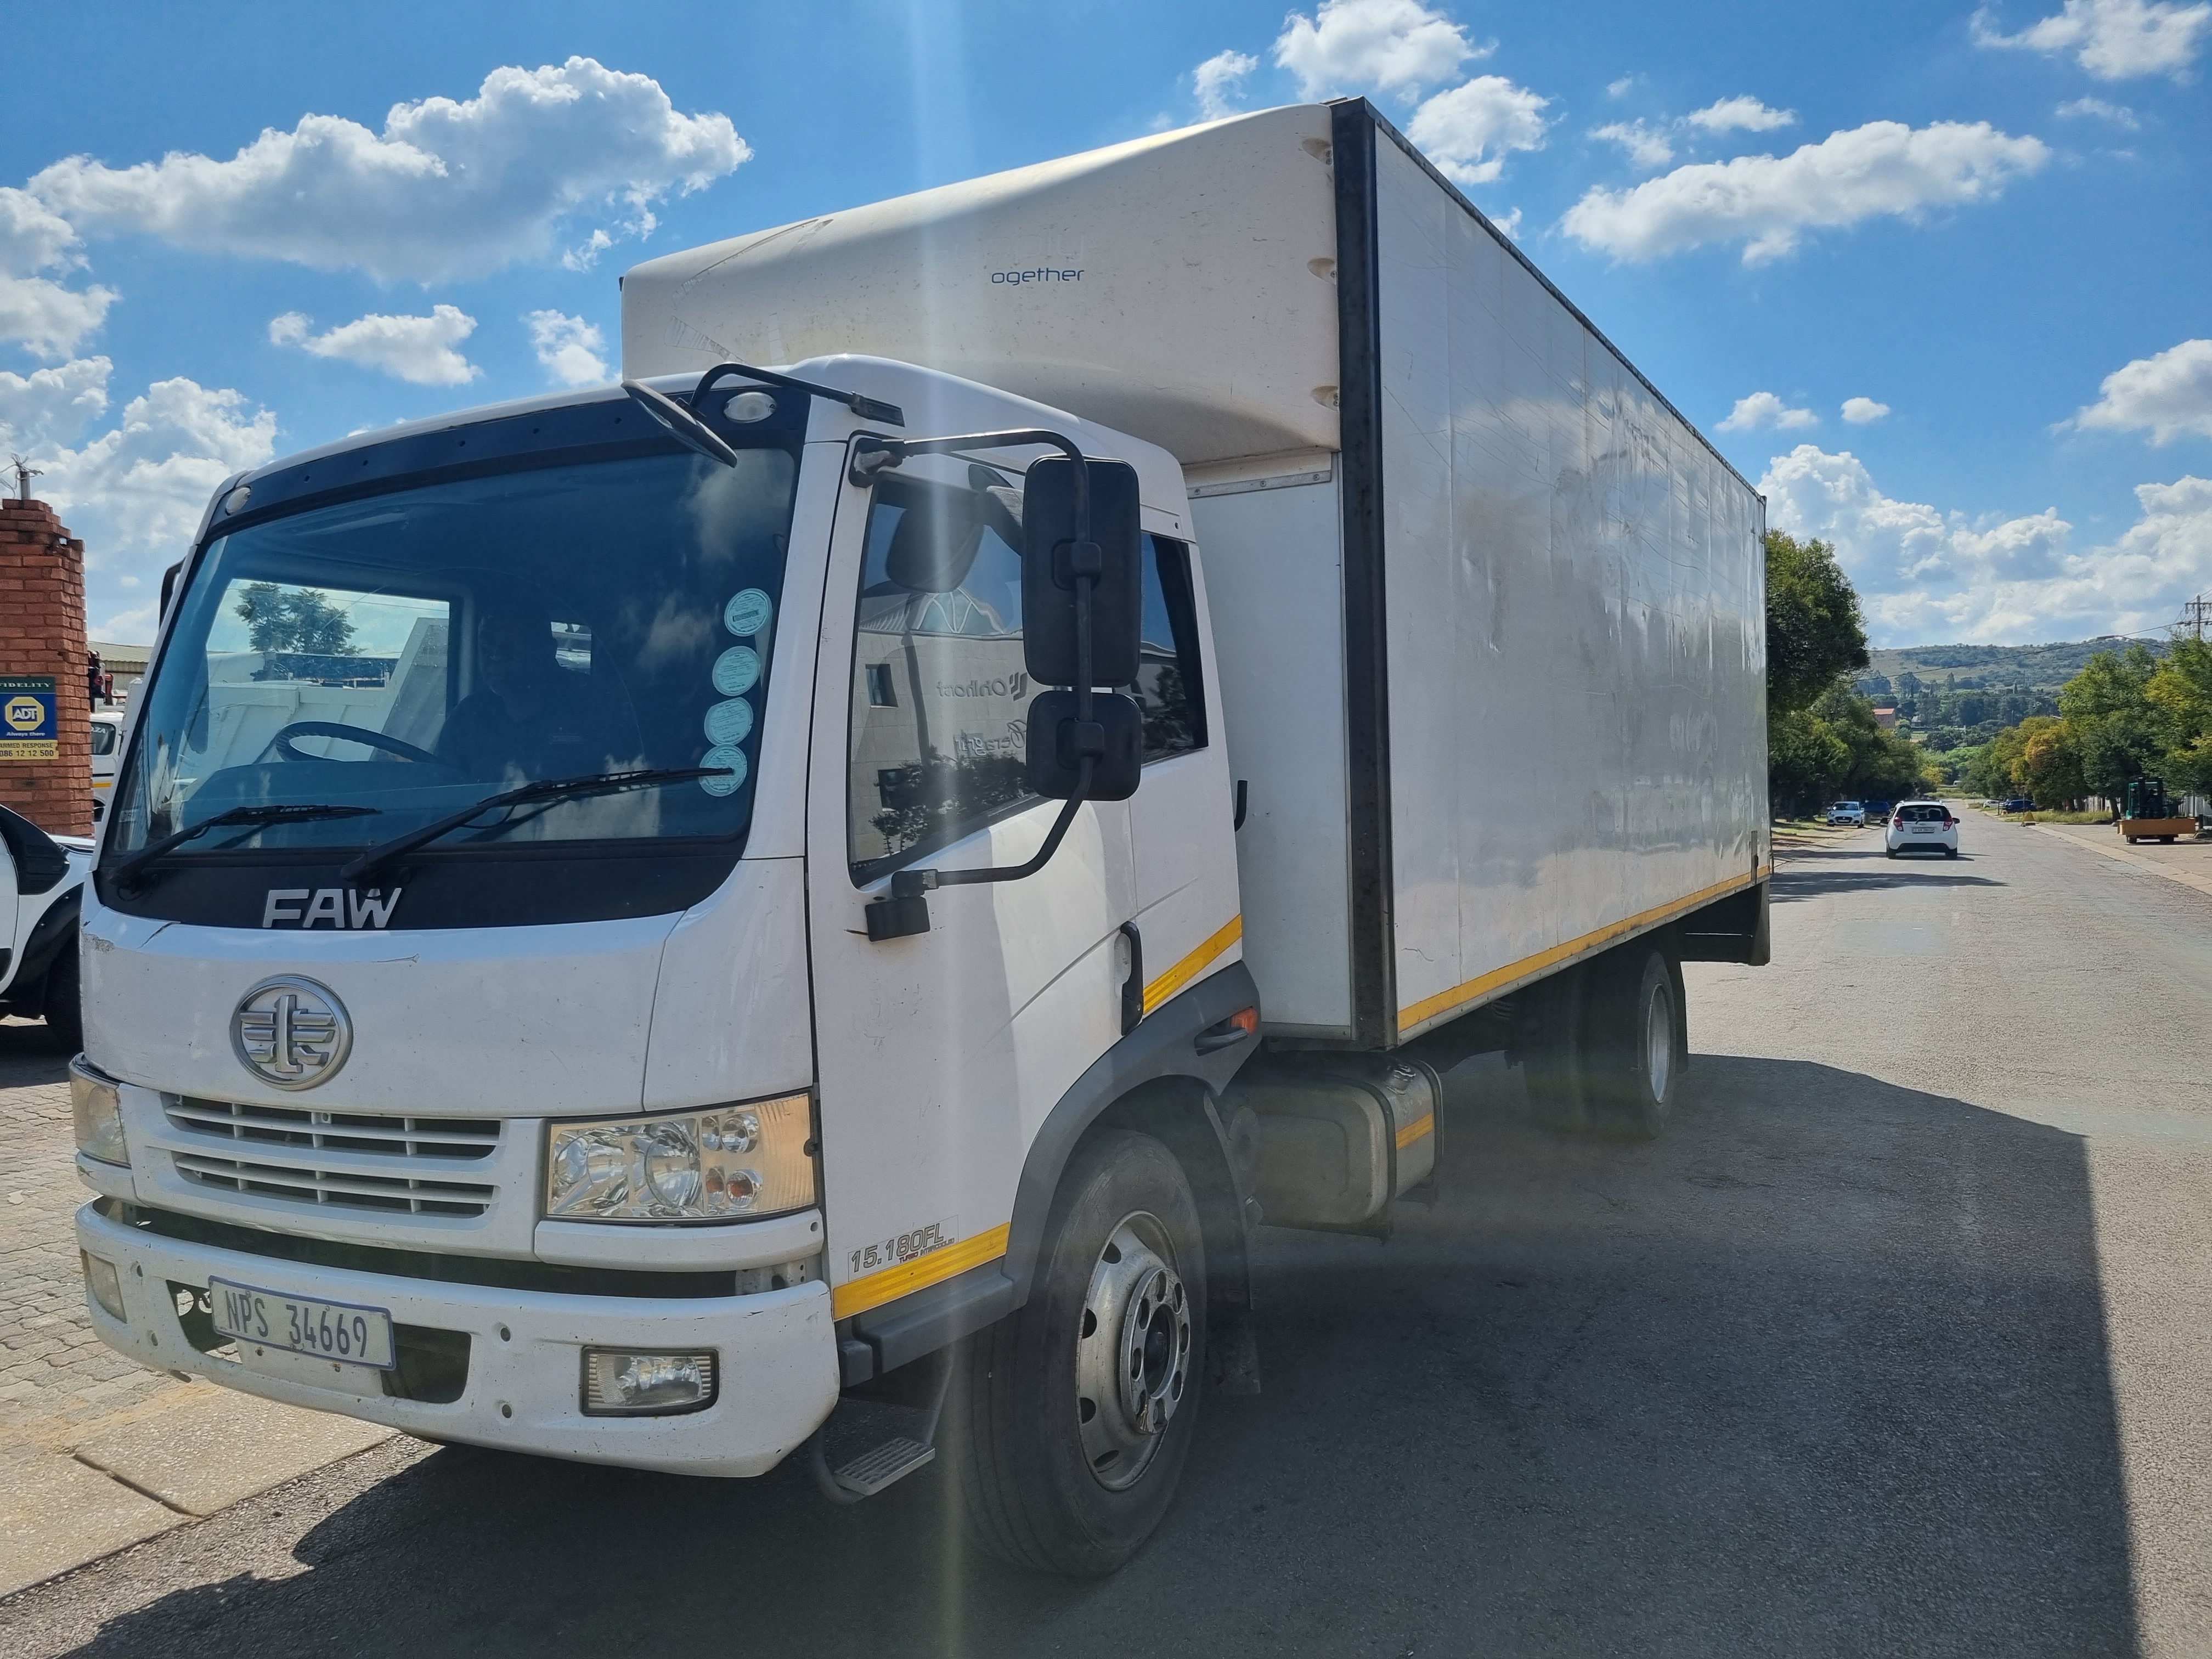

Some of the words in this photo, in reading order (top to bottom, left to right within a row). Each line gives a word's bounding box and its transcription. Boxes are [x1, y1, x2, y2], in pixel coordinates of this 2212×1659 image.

[991, 267, 1085, 286] ogether
[13, 708, 37, 720] ADT
[263, 888, 402, 928] FAW
[851, 1223, 944, 1273] 15.180FL
[225, 1290, 269, 1337] NPS
[286, 1304, 368, 1358] 34669
